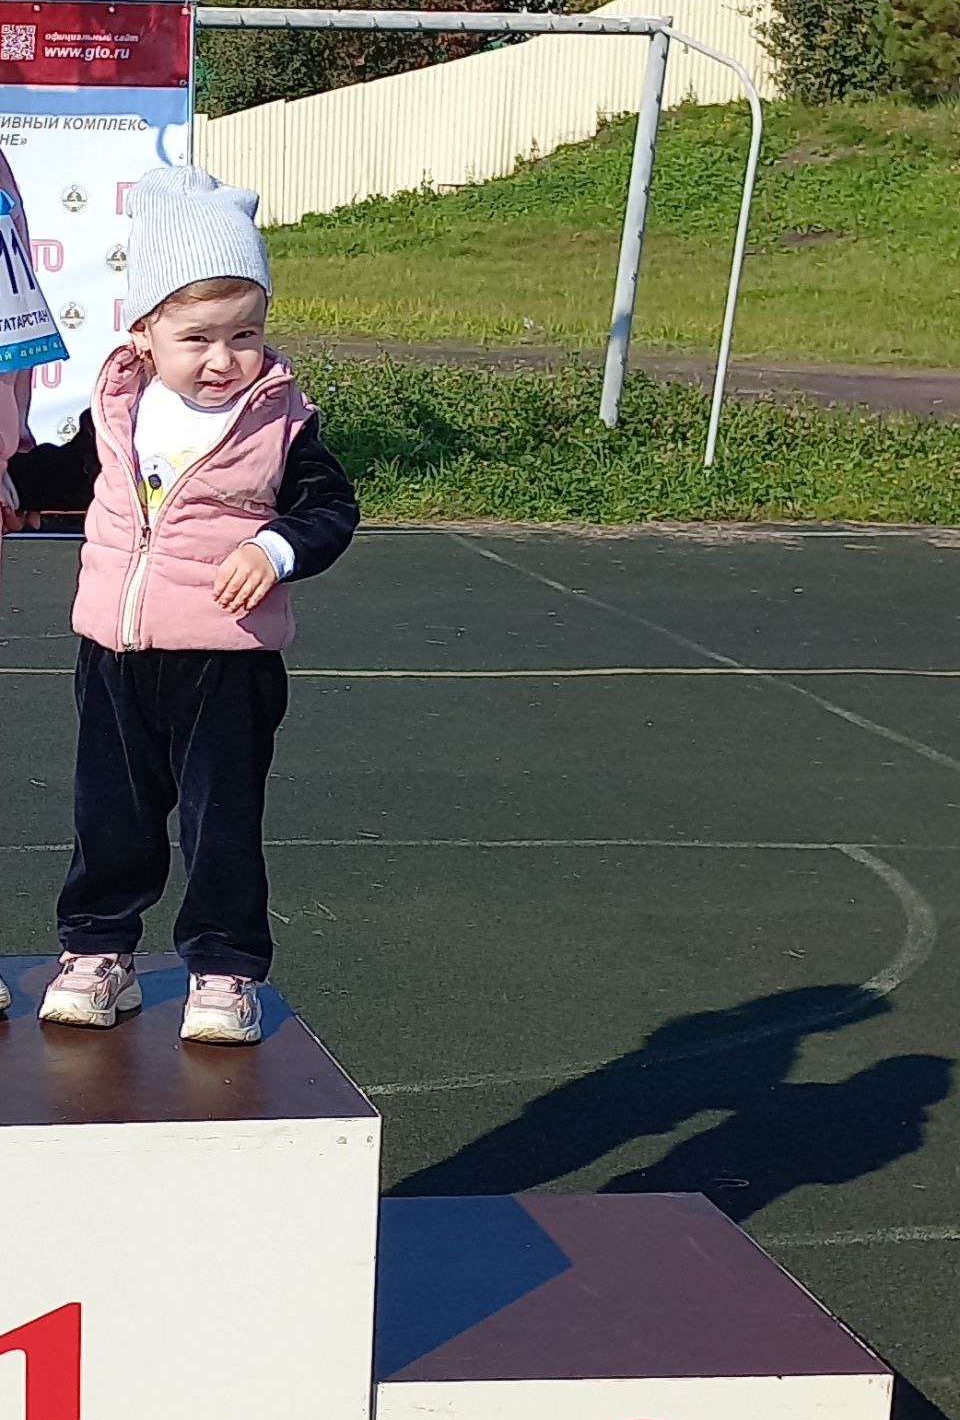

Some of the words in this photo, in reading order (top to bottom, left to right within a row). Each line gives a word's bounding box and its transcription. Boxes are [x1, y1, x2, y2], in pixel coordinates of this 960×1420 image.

[44, 45, 130, 61] www.gto.ru
[63, 116, 148, 131] КОМПЛЕКС
[31, 239, 64, 272] ТО
